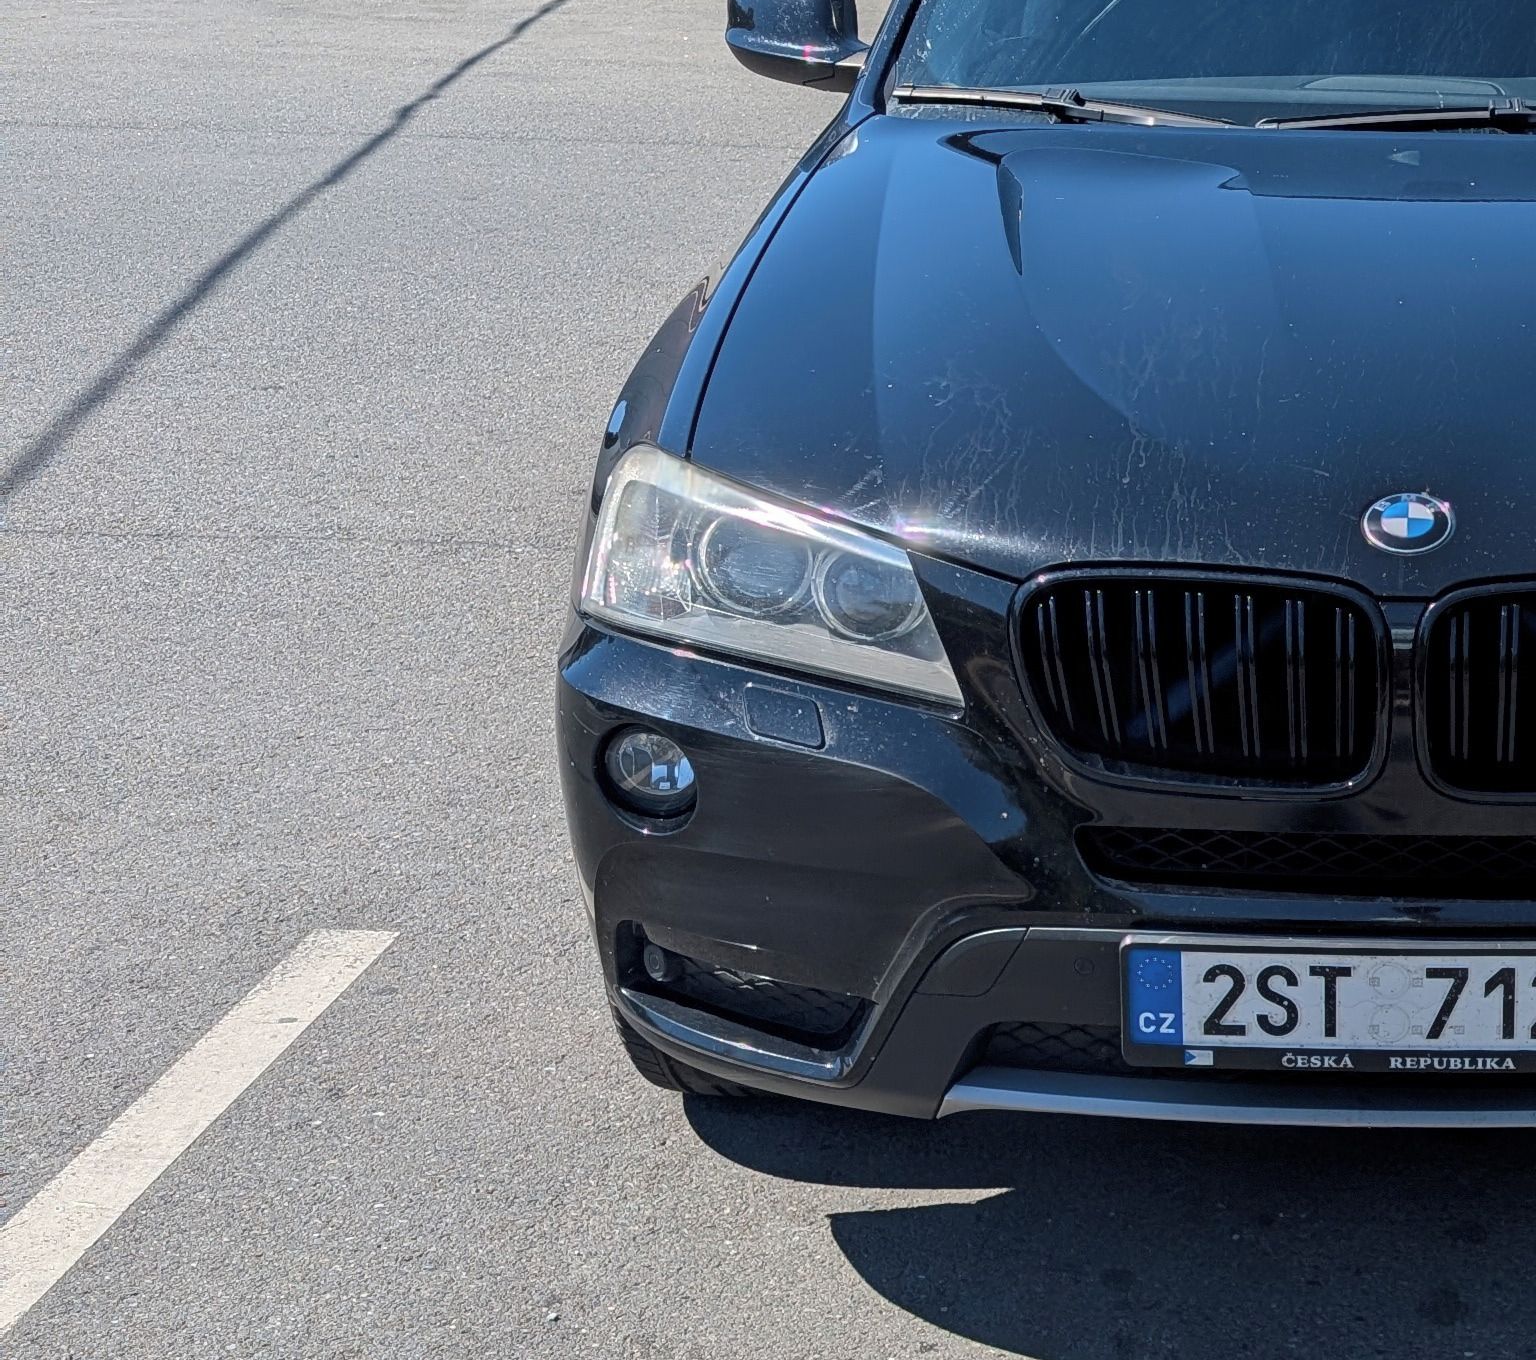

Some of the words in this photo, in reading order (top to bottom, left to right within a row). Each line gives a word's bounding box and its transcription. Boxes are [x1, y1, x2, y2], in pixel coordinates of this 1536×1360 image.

[1374, 494, 1441, 513] BMW
[1202, 963, 1353, 1038] 2ST
[1138, 1012, 1176, 1034] CZ
[1281, 1052, 1354, 1069] ČESKÁ
[1388, 1056, 1517, 1071] REPUBLIKA
